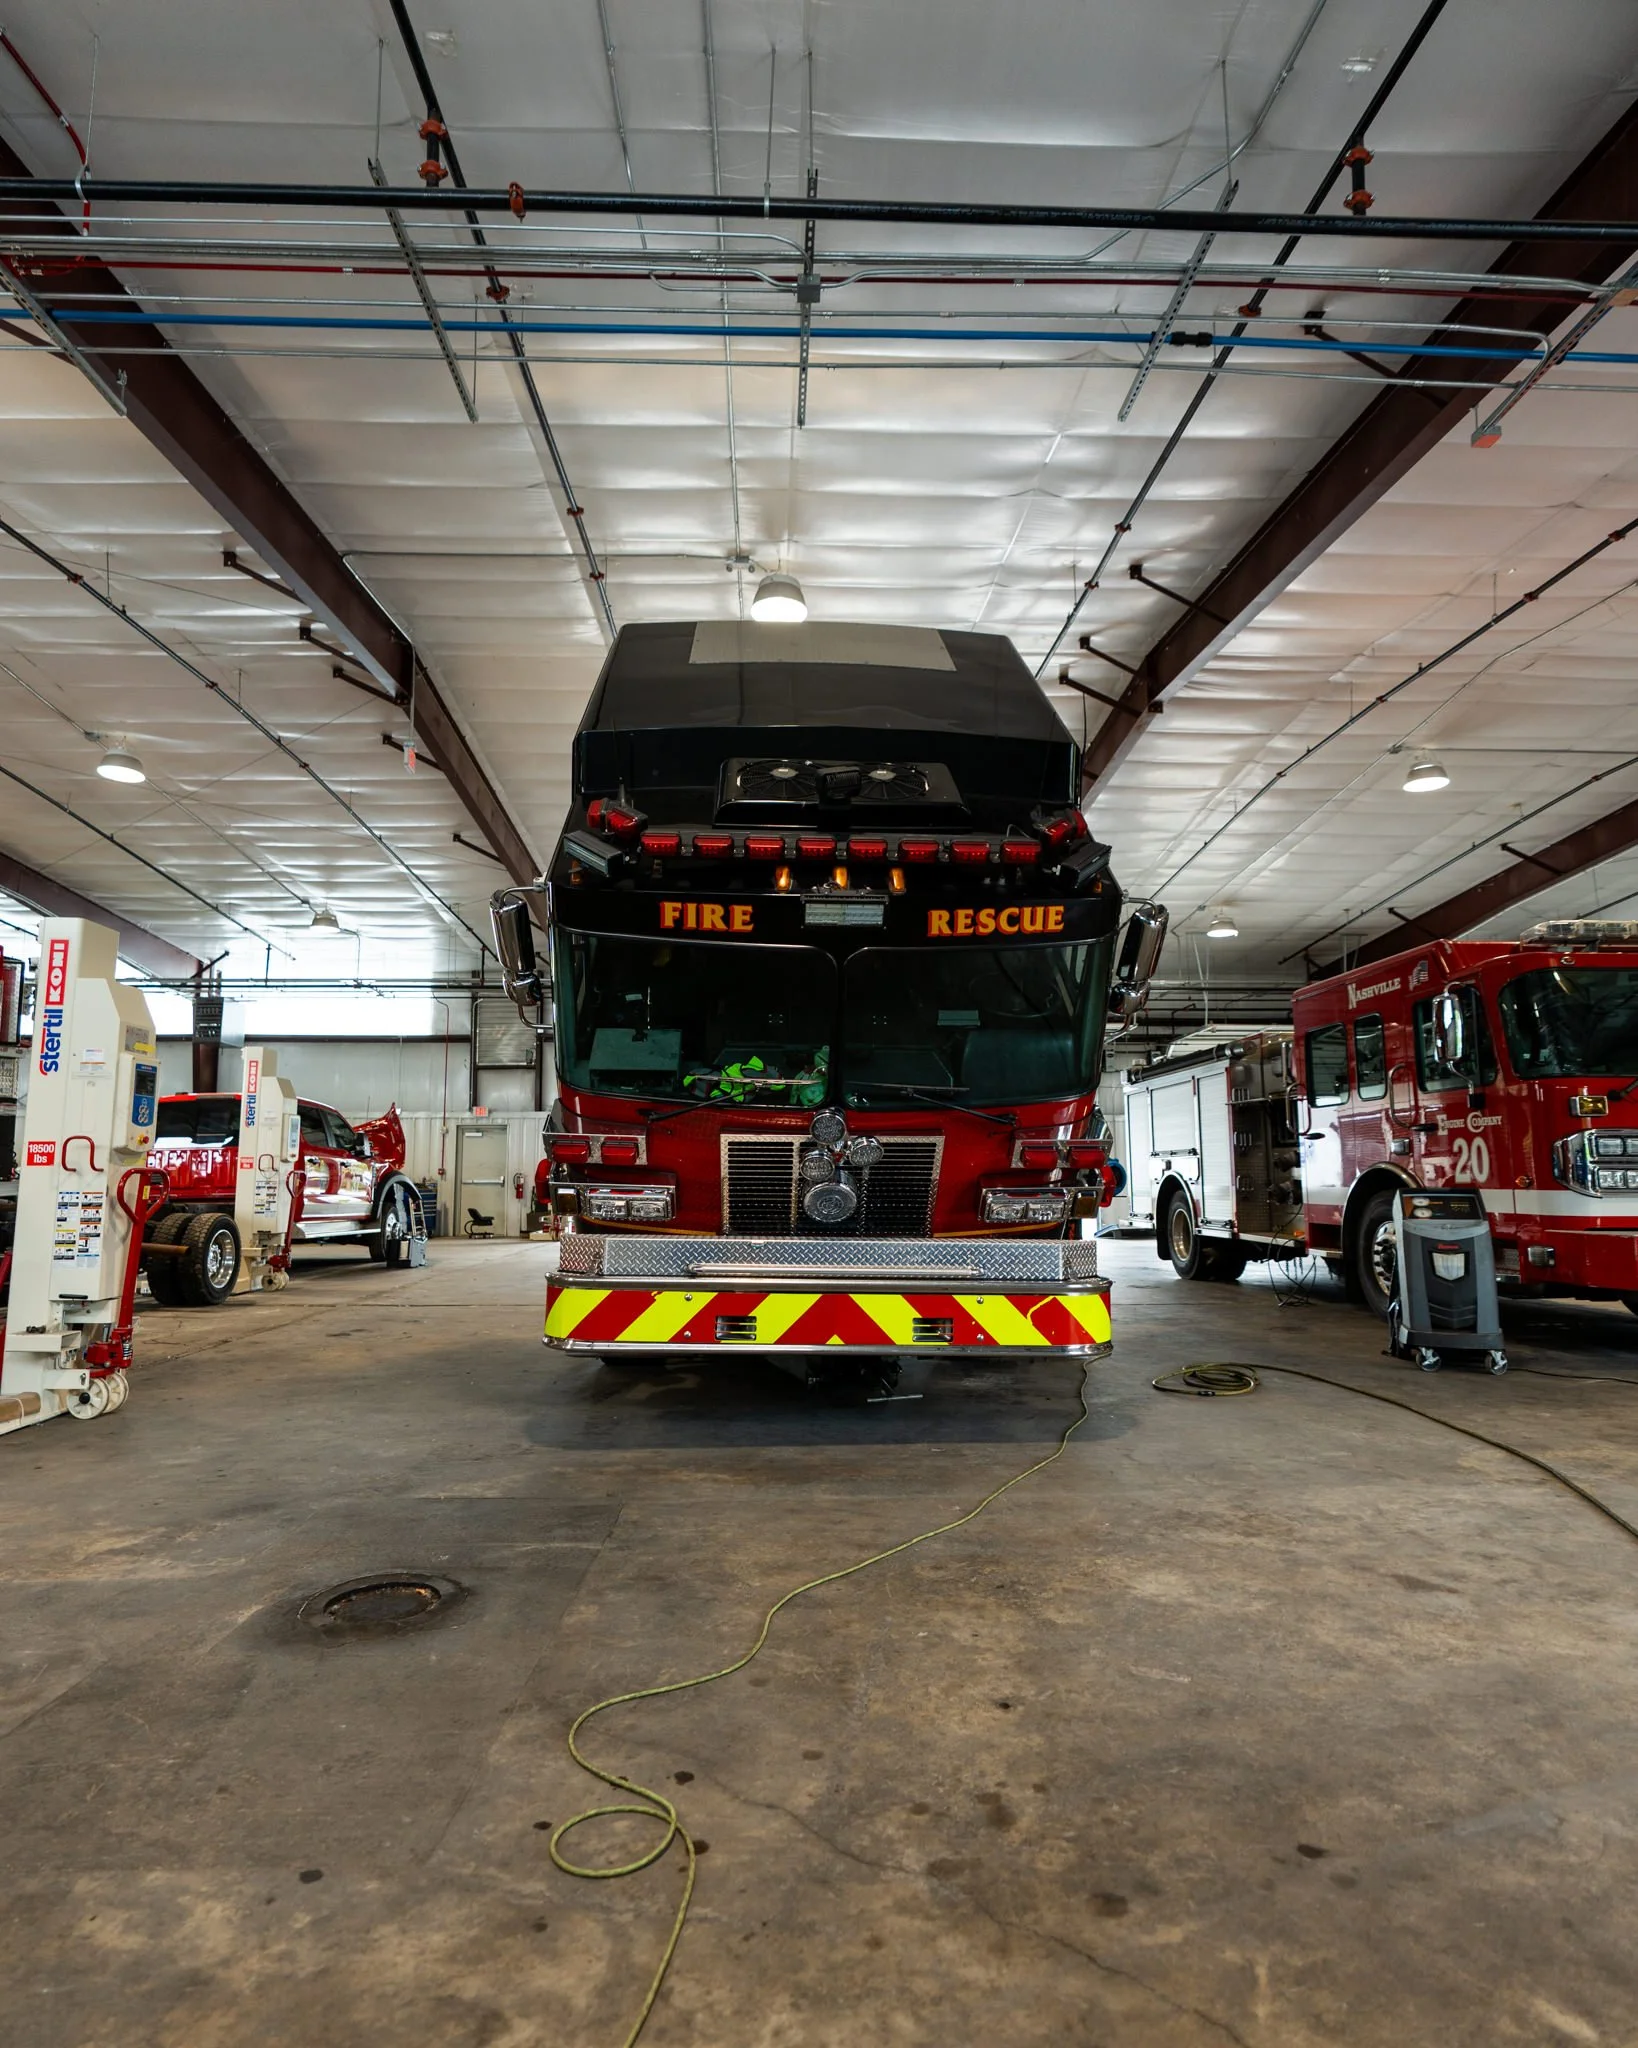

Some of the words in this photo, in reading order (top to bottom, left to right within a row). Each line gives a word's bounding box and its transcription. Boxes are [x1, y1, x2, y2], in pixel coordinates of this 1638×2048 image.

[660, 901, 754, 932] FIRE
[927, 905, 1065, 937] RESCUE
[48, 942, 66, 1003] KONI
[40, 1009, 63, 1075] stertil
[29, 1143, 55, 1153] 18500
[33, 1153, 48, 1163] lbs
[1453, 1136, 1490, 1184] 20
